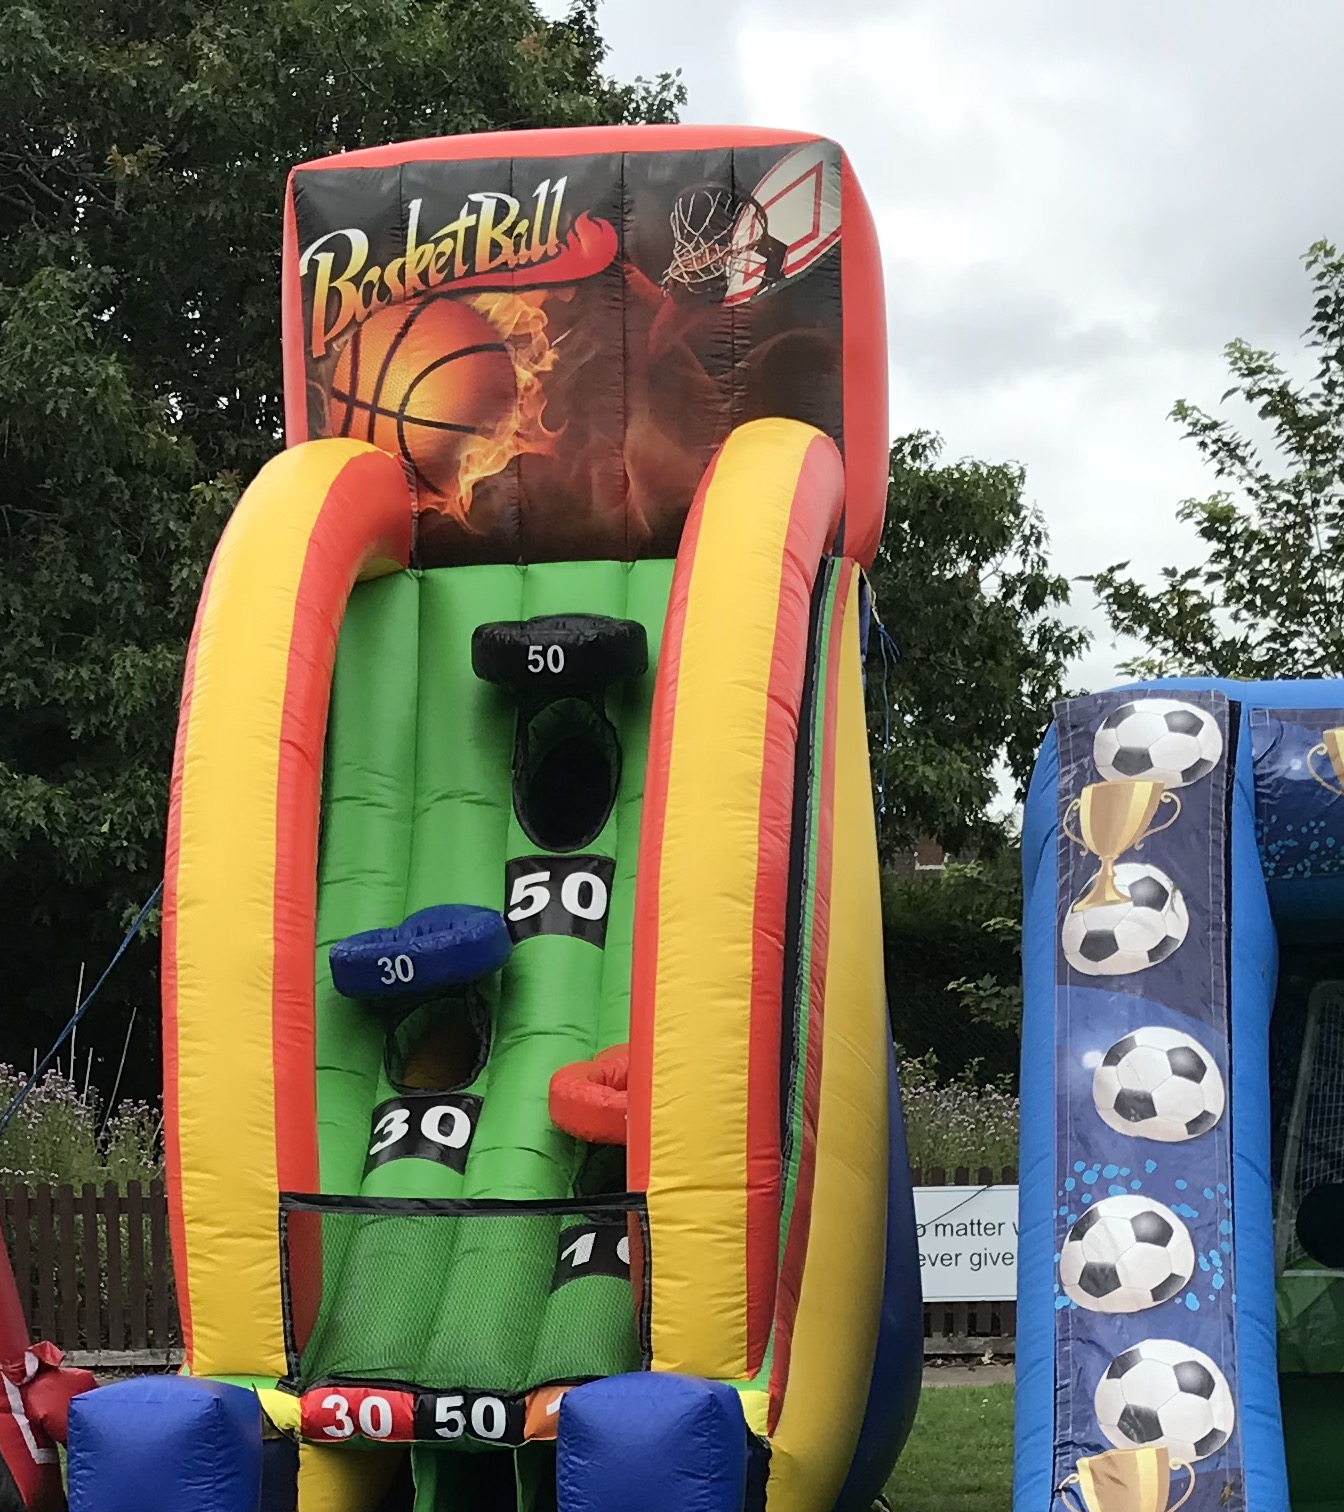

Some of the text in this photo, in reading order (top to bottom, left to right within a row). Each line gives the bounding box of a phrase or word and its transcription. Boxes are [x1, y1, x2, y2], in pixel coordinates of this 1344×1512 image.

[527, 644, 565, 674] 50
[507, 871, 608, 921] 50
[377, 954, 415, 985] 30
[369, 1105, 471, 1155] 30
[935, 1219, 1006, 1237] matter
[970, 1247, 1015, 1272] give
[321, 1395, 393, 1438] 30
[434, 1396, 507, 1439] 50
